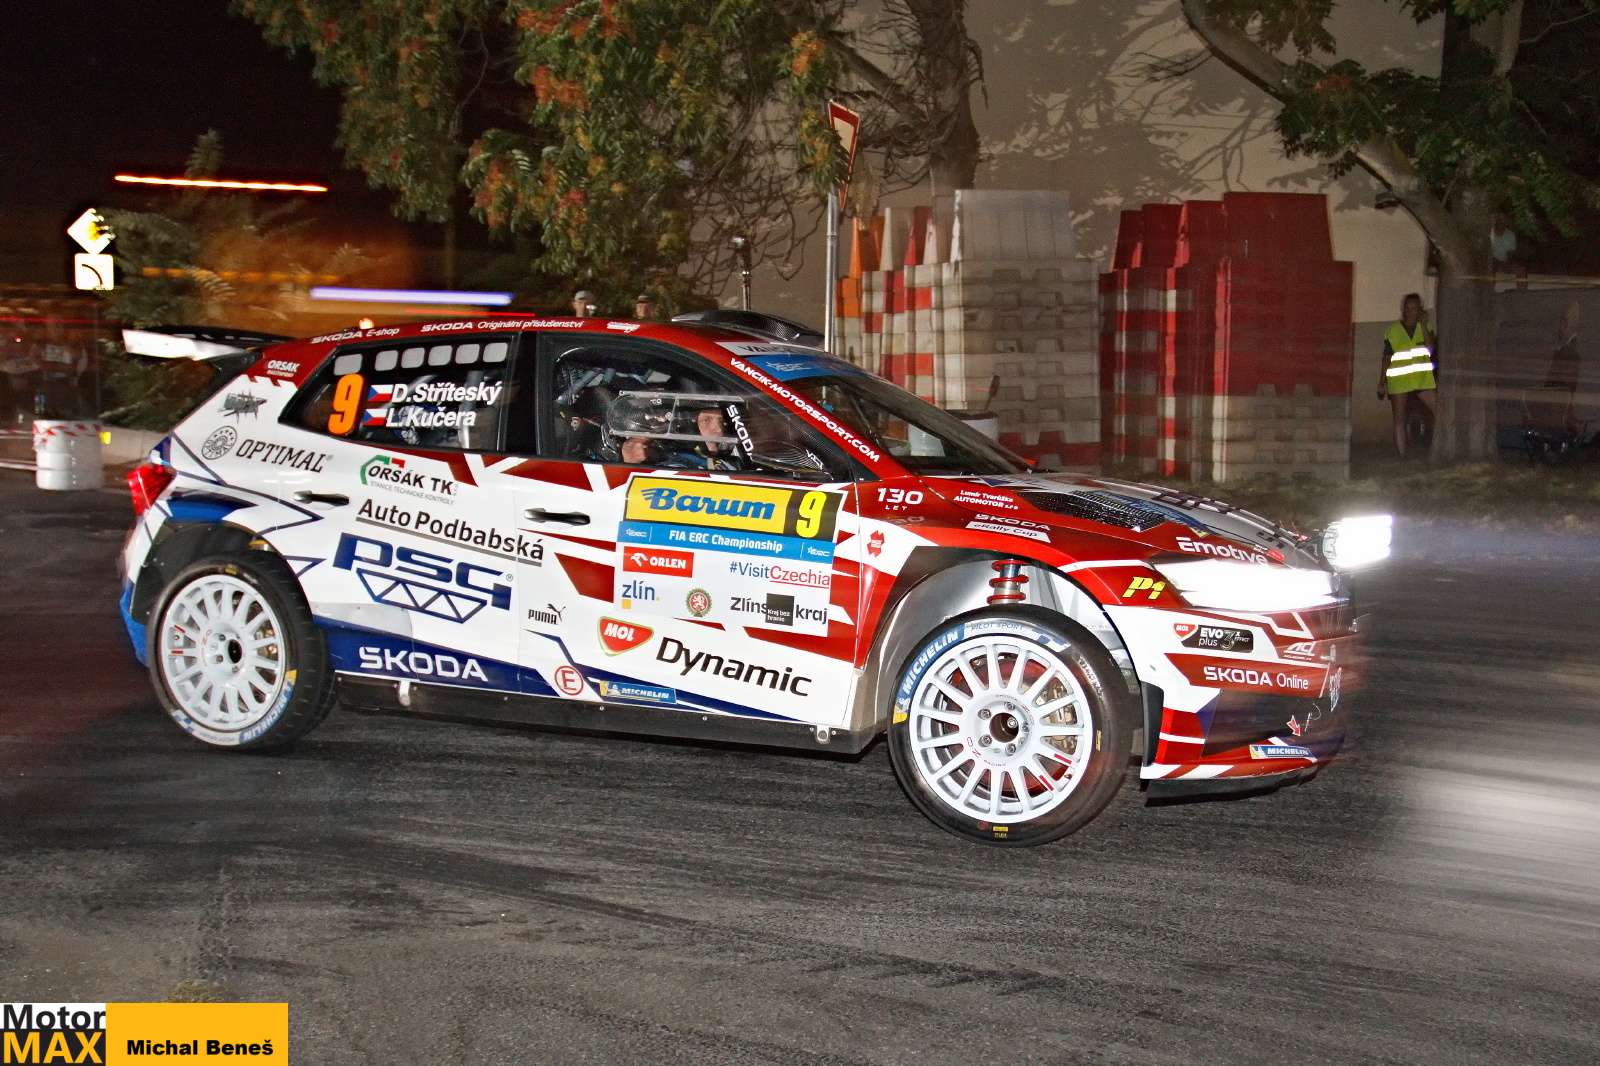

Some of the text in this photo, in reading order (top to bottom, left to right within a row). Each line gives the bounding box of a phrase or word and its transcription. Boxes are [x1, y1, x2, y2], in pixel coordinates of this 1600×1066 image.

[327, 373, 364, 435] 9
[236, 439, 326, 473] OPTIMAL
[878, 487, 924, 505] 130
[953, 496, 1004, 508] AUTOMOTOR
[645, 488, 827, 537] Barum 9
[358, 499, 544, 560] Auto Podbabská
[1012, 529, 1038, 537] Cup
[669, 530, 783, 553] FIA ERC Championship
[1176, 537, 1268, 566] Emotive
[650, 557, 686, 570] ORLEN
[729, 561, 830, 586] #VisitCzechia
[1122, 577, 1166, 600] P1
[528, 609, 558, 625] PUMA
[795, 605, 828, 624] kraj
[603, 622, 635, 642] MOL
[1199, 637, 1218, 647] plus
[1200, 627, 1223, 639] EVO
[656, 637, 812, 696] Dynamic
[902, 631, 959, 695] MICHELIN
[561, 669, 580, 692] E
[1277, 672, 1309, 689] Online
[622, 687, 670, 699] MICHELIN
[1268, 747, 1310, 755] MICHELIN
